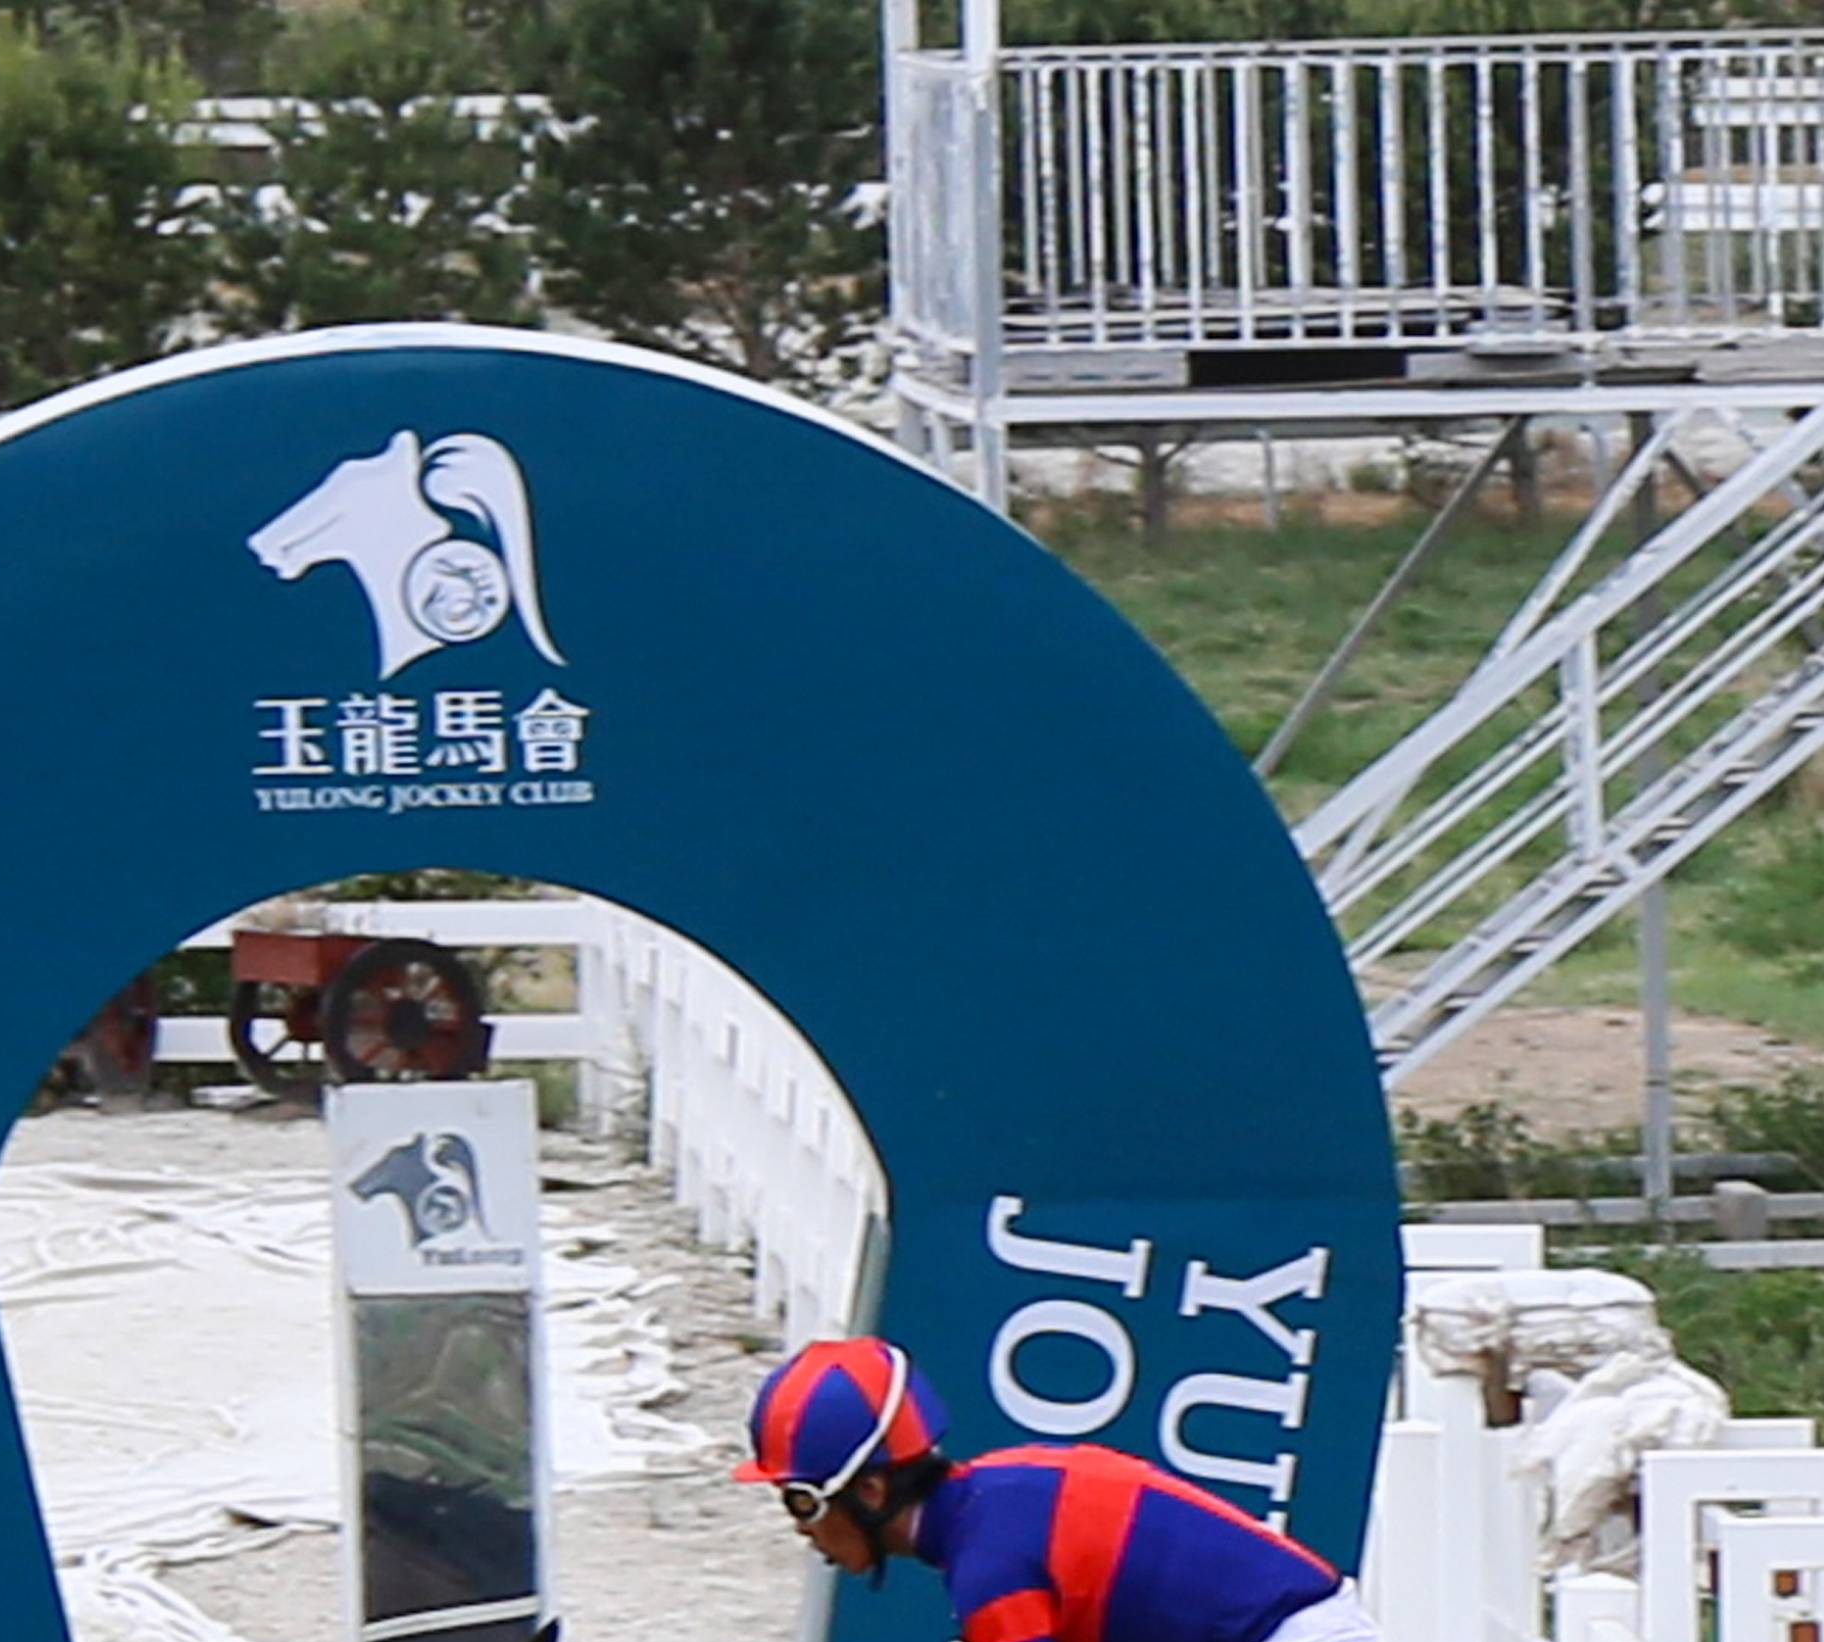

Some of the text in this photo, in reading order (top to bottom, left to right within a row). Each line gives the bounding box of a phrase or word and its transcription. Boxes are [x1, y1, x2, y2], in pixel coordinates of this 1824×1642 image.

[252, 688, 590, 776] 玉龍馬會
[255, 780, 594, 814] YULONG JOCKEY CLUB
